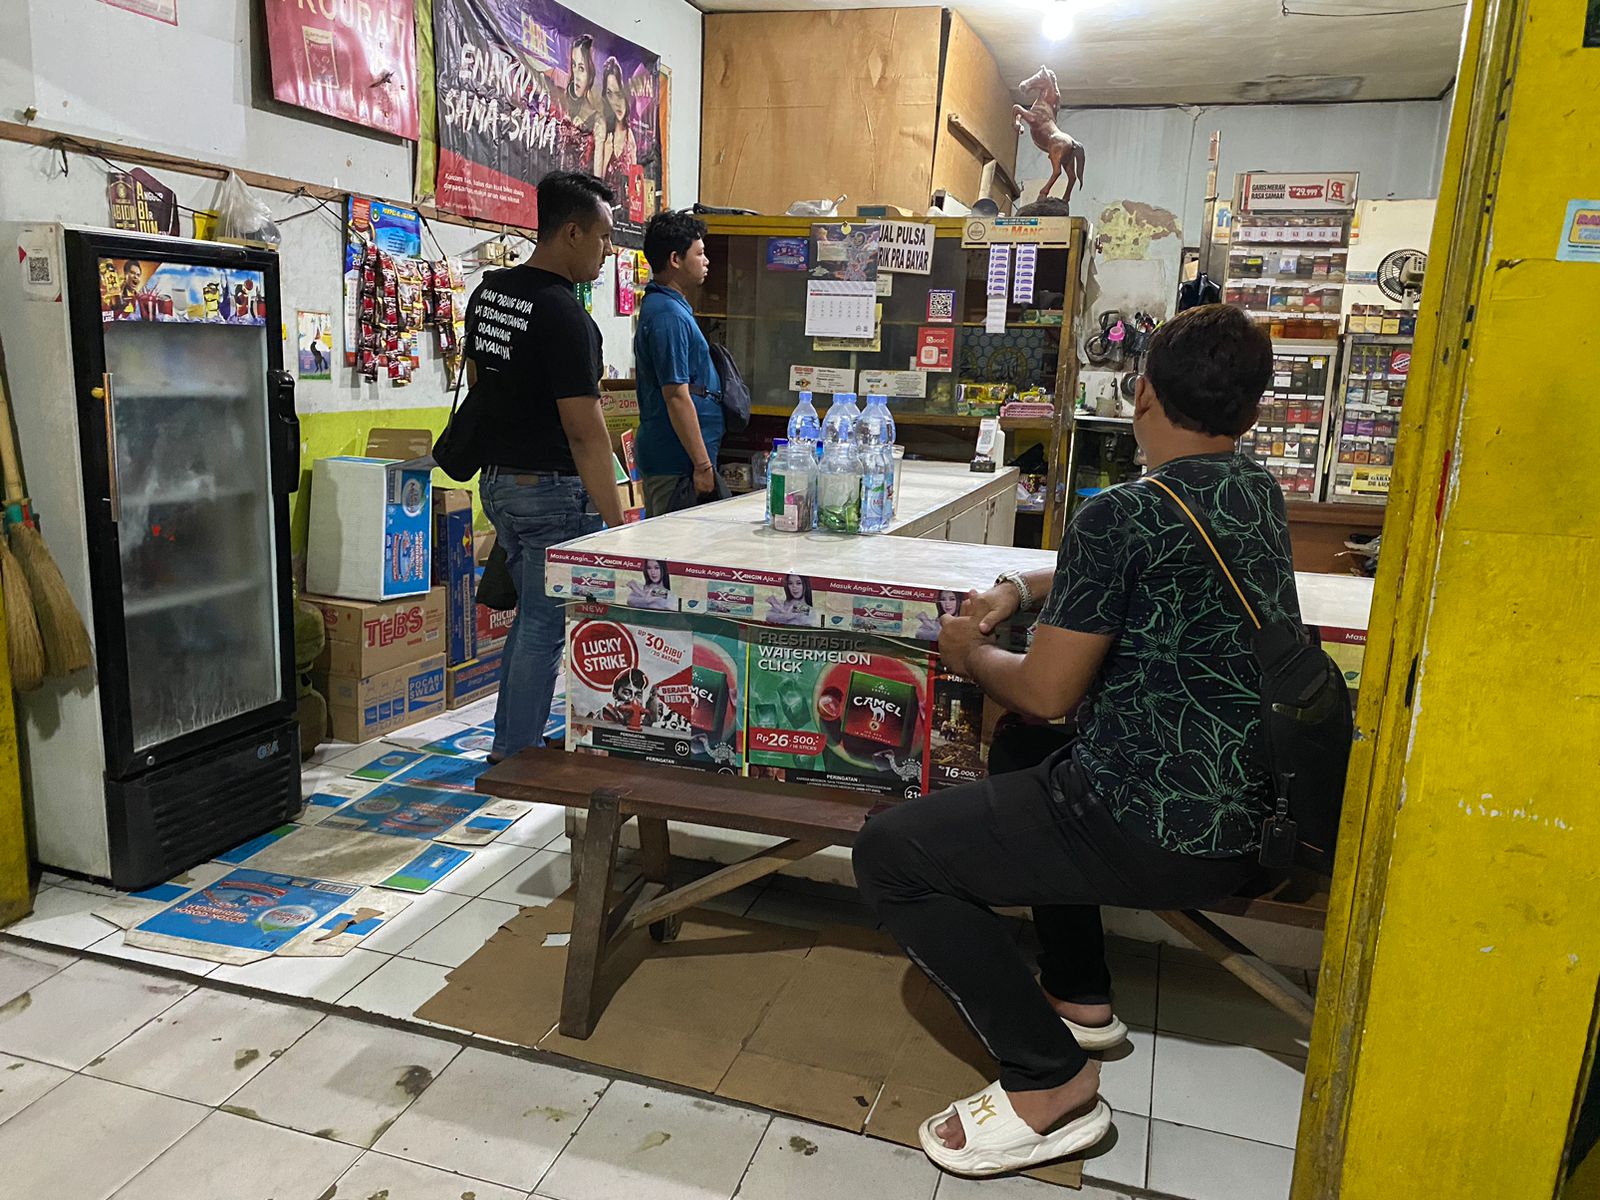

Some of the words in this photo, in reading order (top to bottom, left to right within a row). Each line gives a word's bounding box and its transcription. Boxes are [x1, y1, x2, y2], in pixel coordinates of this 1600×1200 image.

[445, 87, 558, 155] SAMA-SAMA
[896, 226, 926, 246] PULSA
[890, 248, 905, 269] PRA
[906, 249, 929, 271] BAYAR
[515, 298, 534, 315] KAYA
[549, 552, 570, 562] Masuk
[685, 566, 706, 576] Masuk
[581, 576, 609, 587] XANGIN
[829, 581, 853, 592] Masuk
[717, 591, 746, 602] XANGIN
[581, 604, 605, 614] NEW
[863, 606, 895, 619] XANGIN
[364, 606, 424, 648] TEBS
[582, 638, 622, 656] LUCKY
[759, 632, 866, 651] FRESHTASTIC
[583, 654, 628, 673] STRIKE
[758, 645, 872, 667] WATERMELON
[757, 658, 803, 674] CLICK
[408, 673, 443, 689] POCARI
[408, 682, 440, 700] SWEAT
[660, 685, 690, 695] BERANI
[688, 685, 714, 703] MEL
[664, 695, 690, 704] BEDA
[853, 696, 902, 718] CAMEL
[677, 744, 688, 752] 21+
